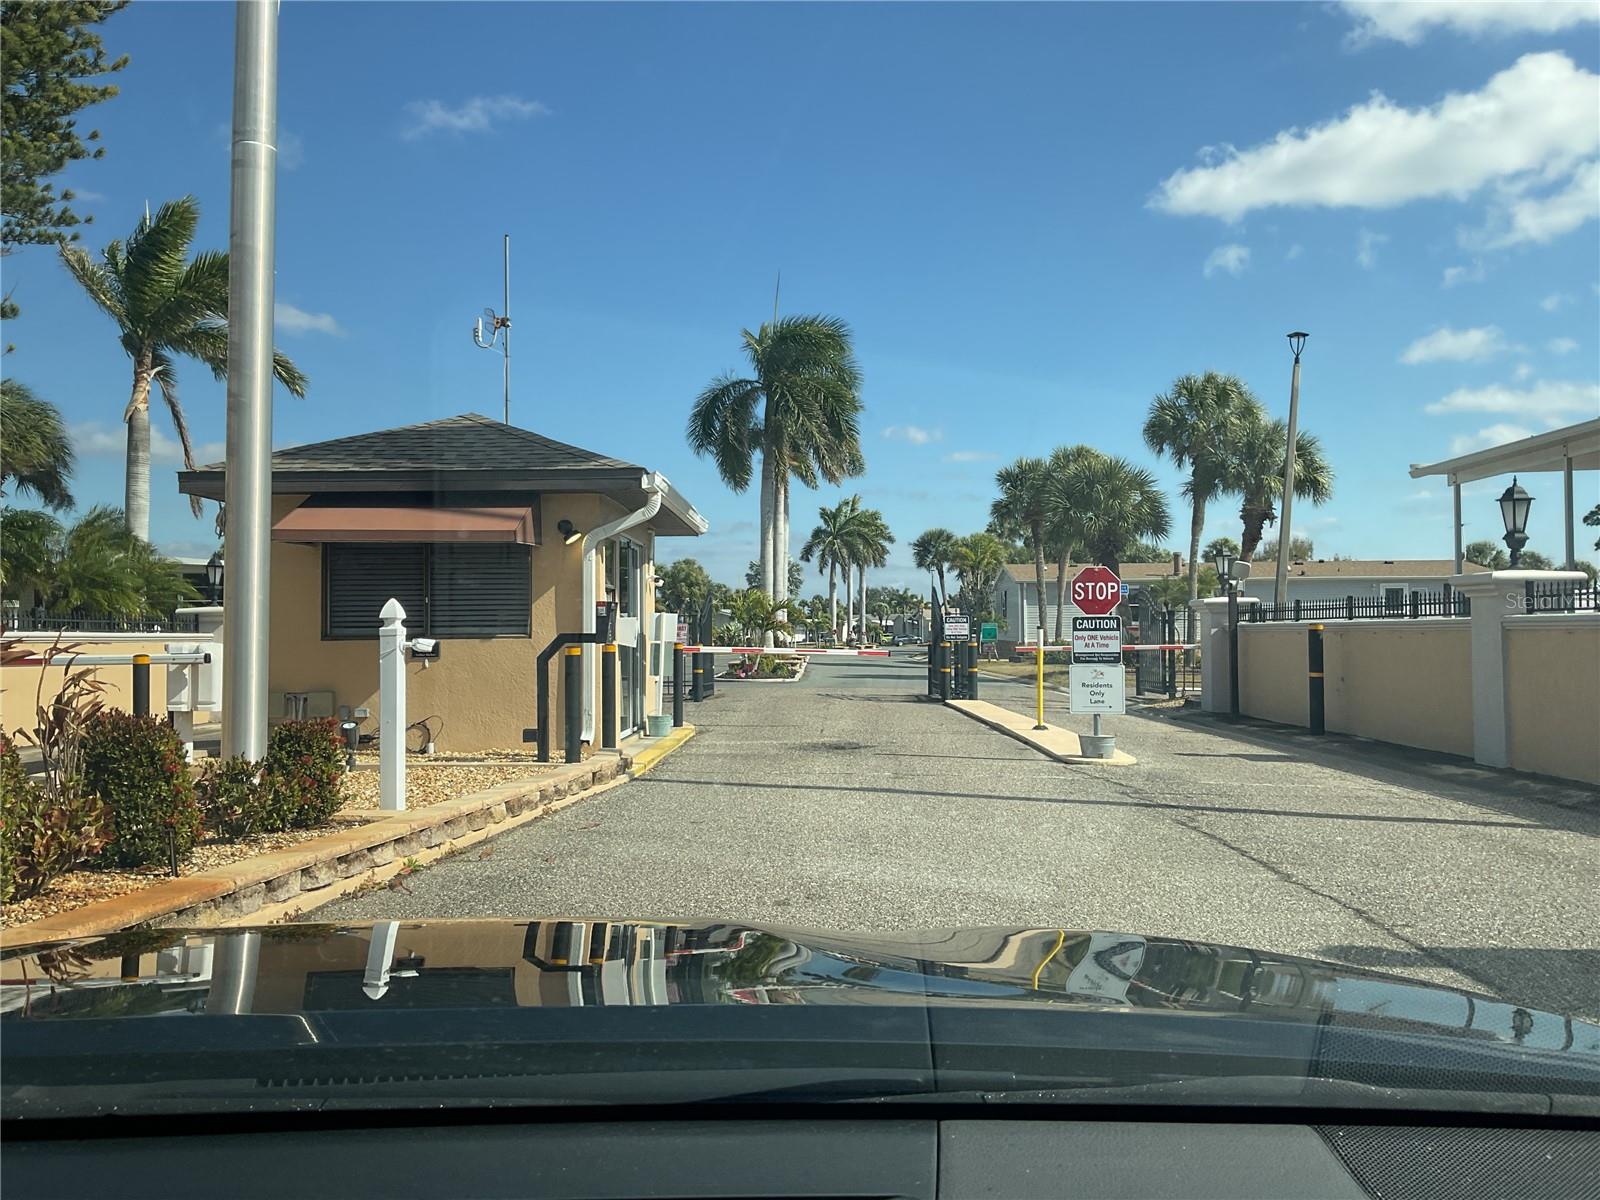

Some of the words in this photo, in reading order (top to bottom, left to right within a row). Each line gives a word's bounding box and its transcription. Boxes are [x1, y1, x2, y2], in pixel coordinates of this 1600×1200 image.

[1074, 582, 1118, 600] STOP
[1076, 619, 1117, 629] CAUTION
[1075, 634, 1086, 642] Only
[1089, 690, 1105, 698] Only
